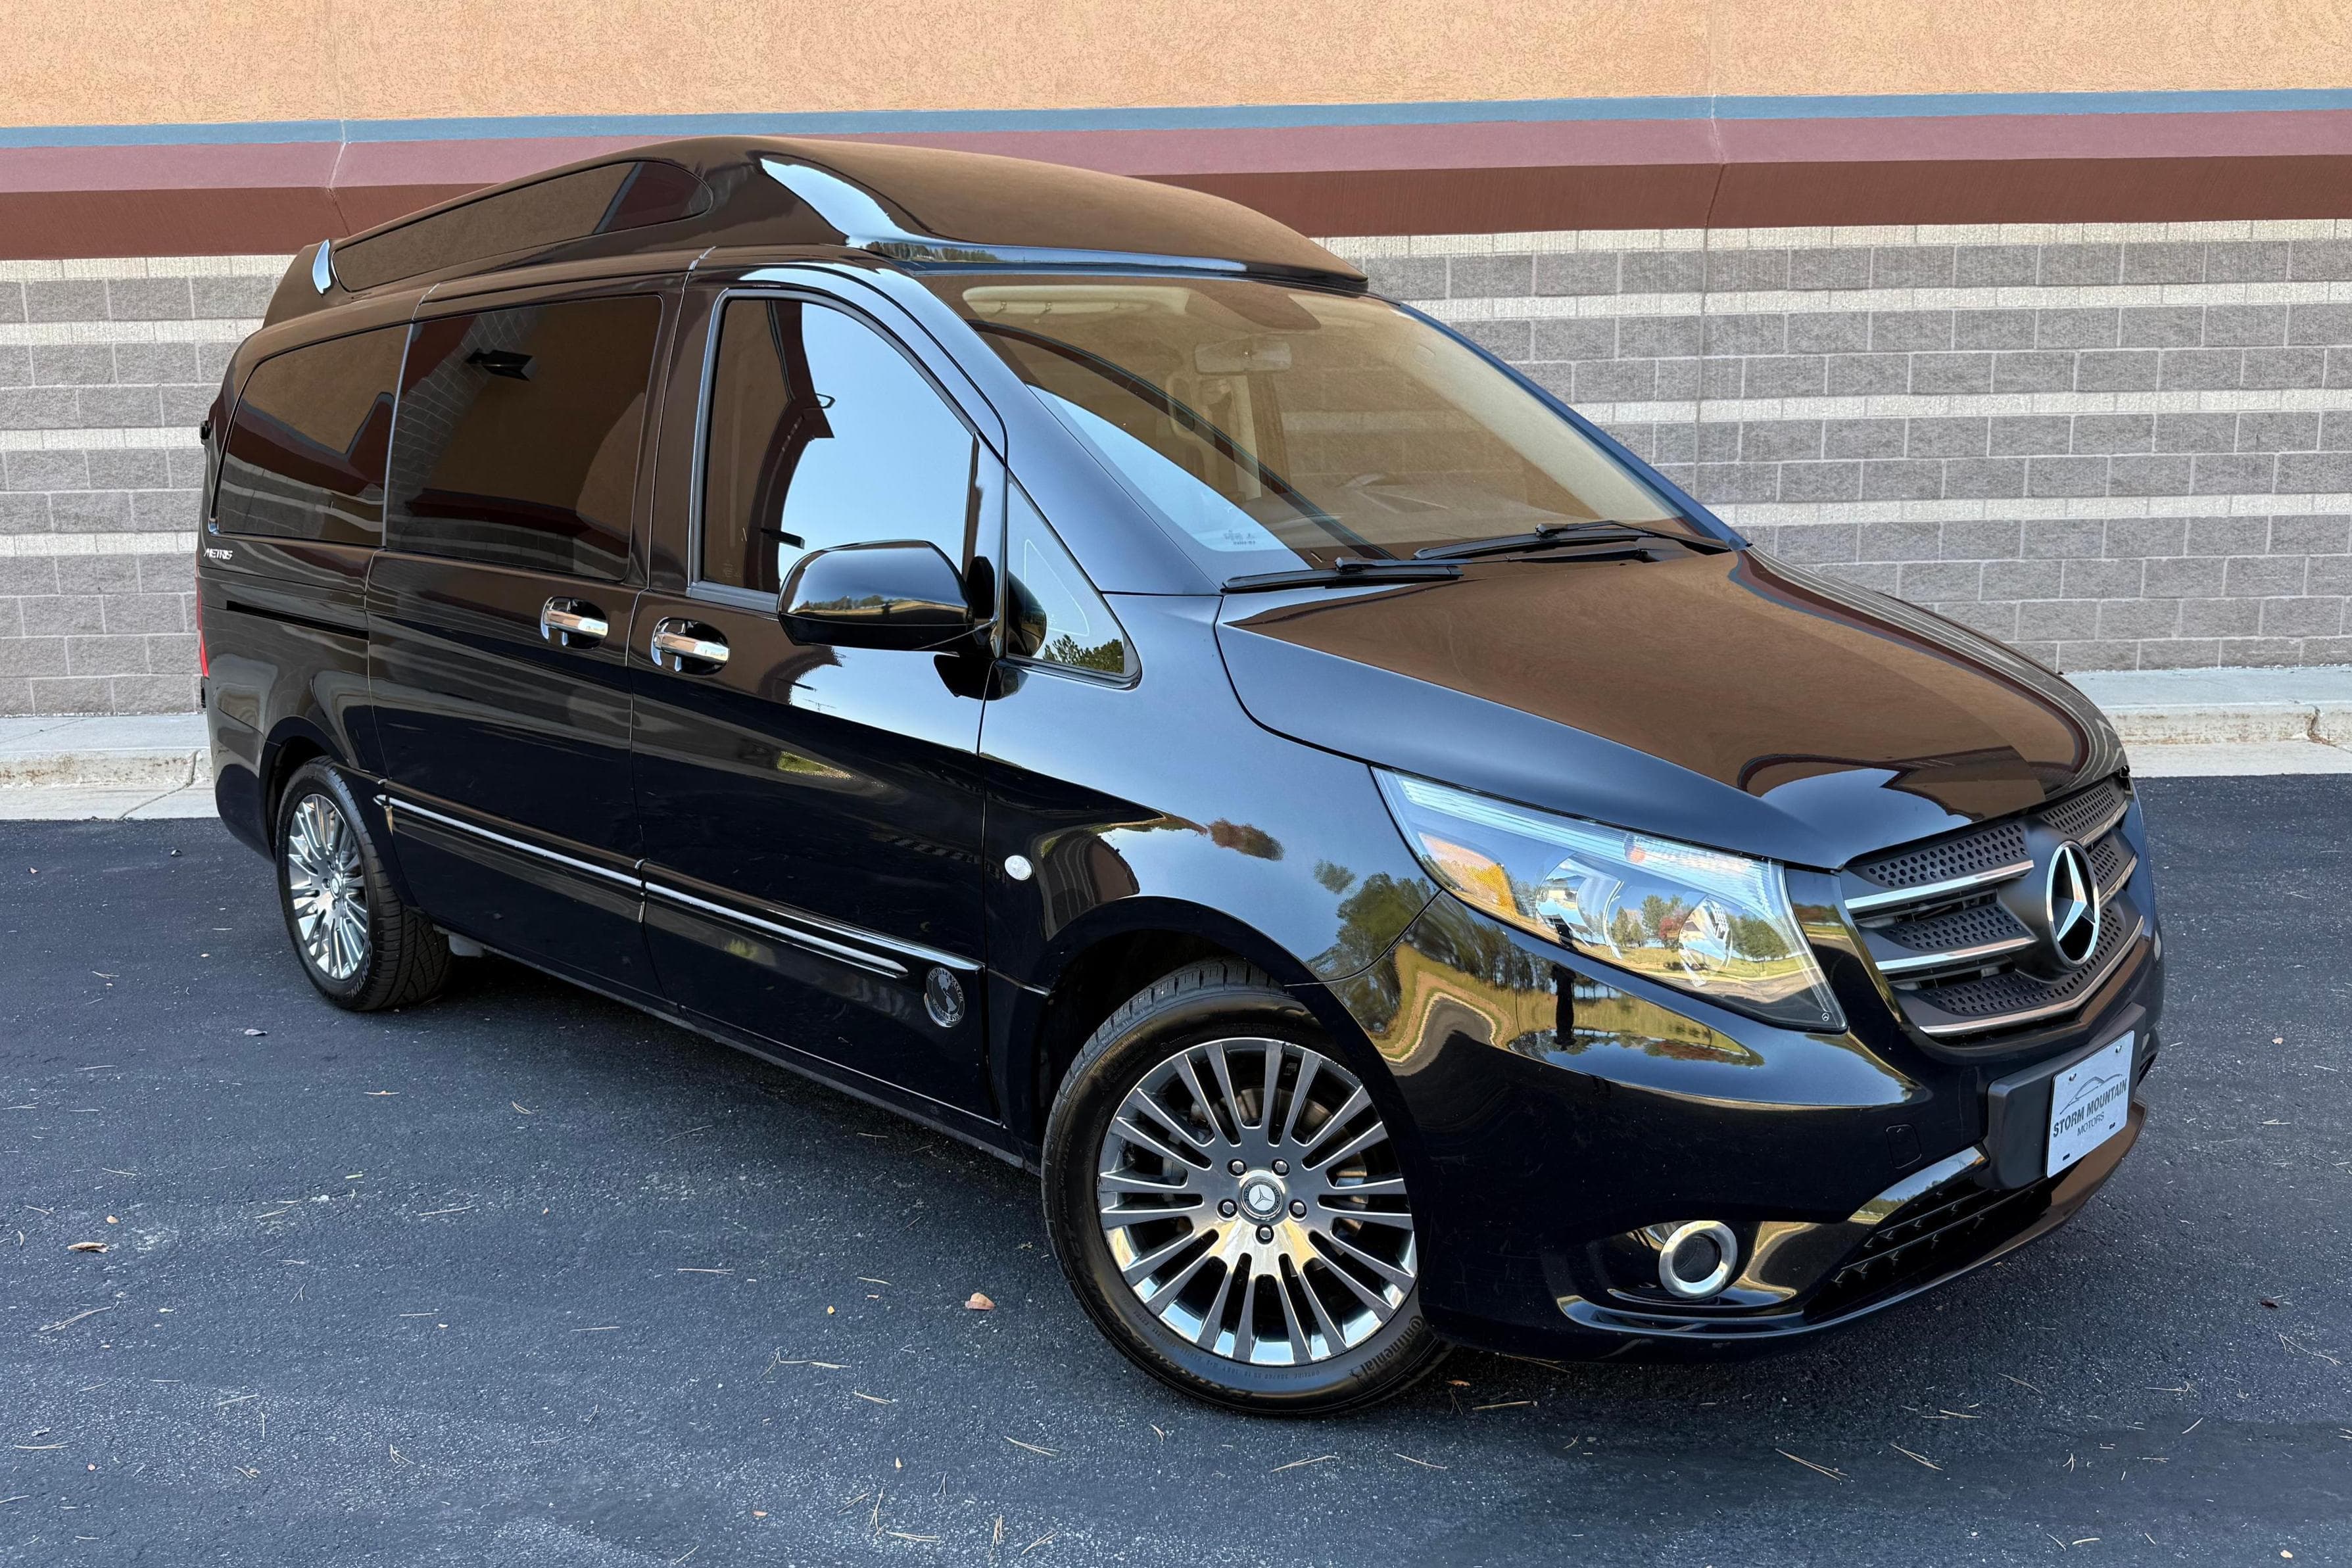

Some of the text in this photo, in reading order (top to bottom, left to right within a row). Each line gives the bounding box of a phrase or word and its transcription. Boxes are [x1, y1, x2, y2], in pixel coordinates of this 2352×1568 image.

[203, 548, 233, 560] METRIS
[2053, 1078, 2127, 1138] STORM MOUNTAIN
[2077, 1111, 2105, 1137] MOTORS
[1359, 1315, 1426, 1375] Continental
